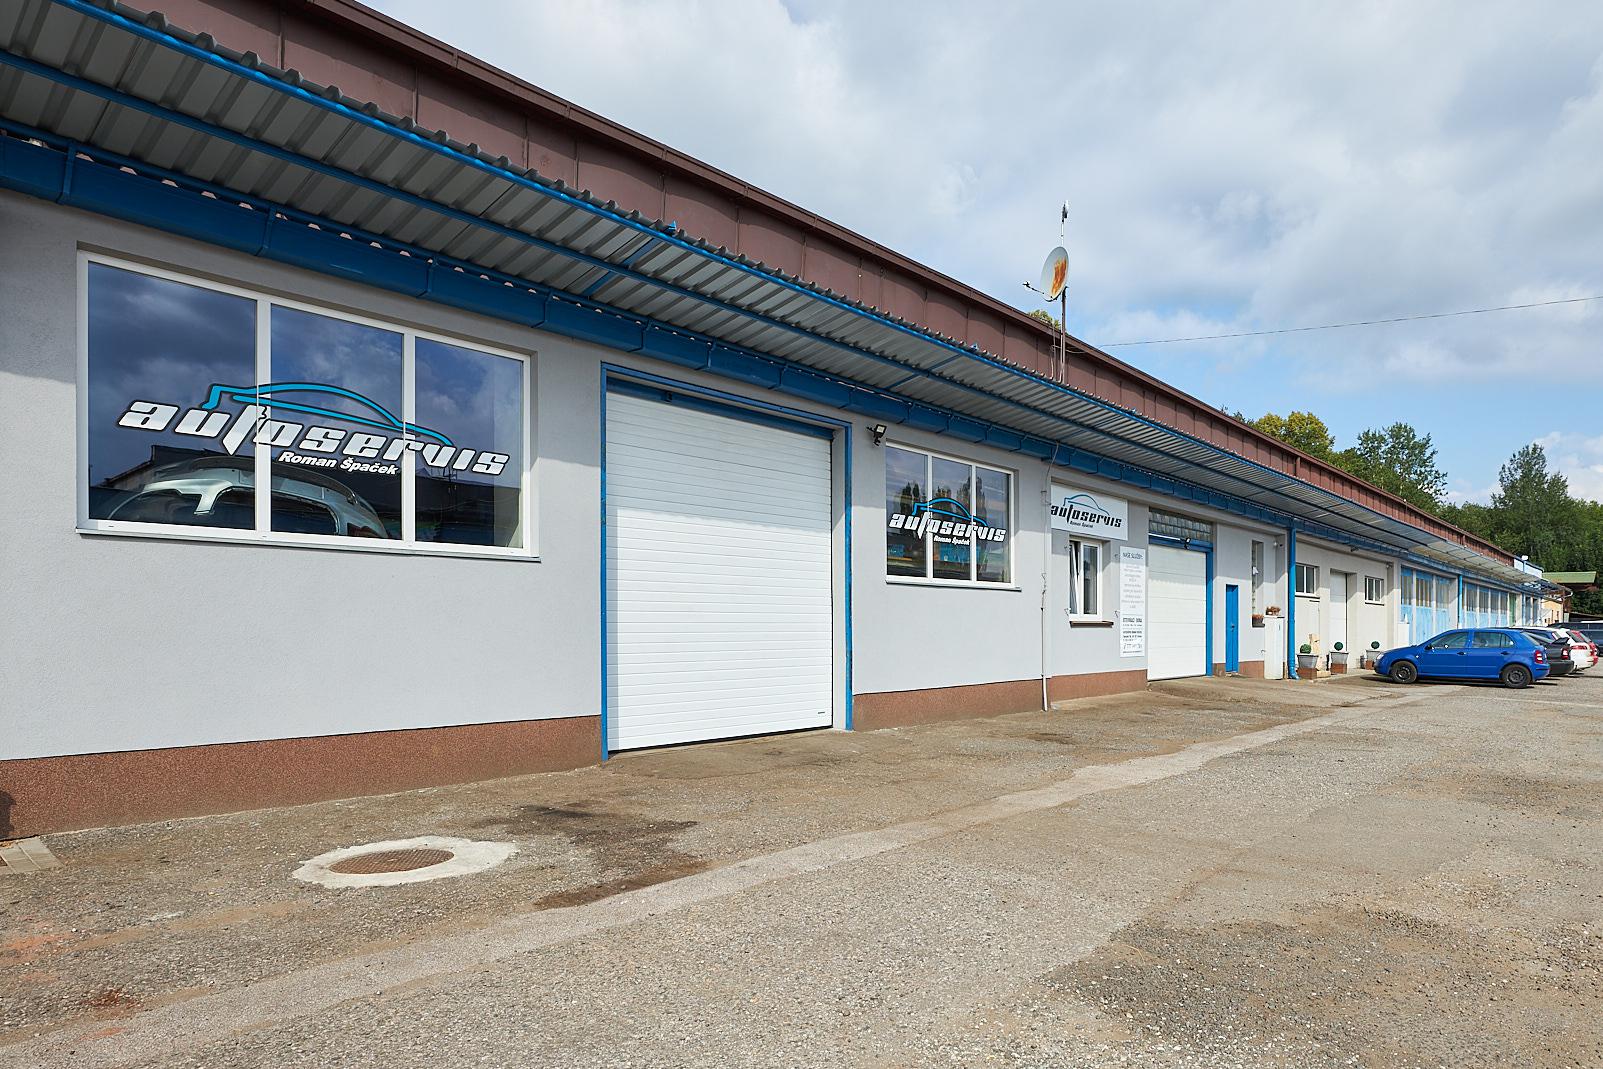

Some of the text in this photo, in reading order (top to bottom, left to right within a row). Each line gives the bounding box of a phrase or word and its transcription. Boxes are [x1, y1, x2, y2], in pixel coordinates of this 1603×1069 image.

[117, 400, 510, 476] autoservis
[278, 450, 399, 476] Roman Špaček
[889, 511, 1007, 542] autoservis
[1050, 503, 1122, 528] autoservis
